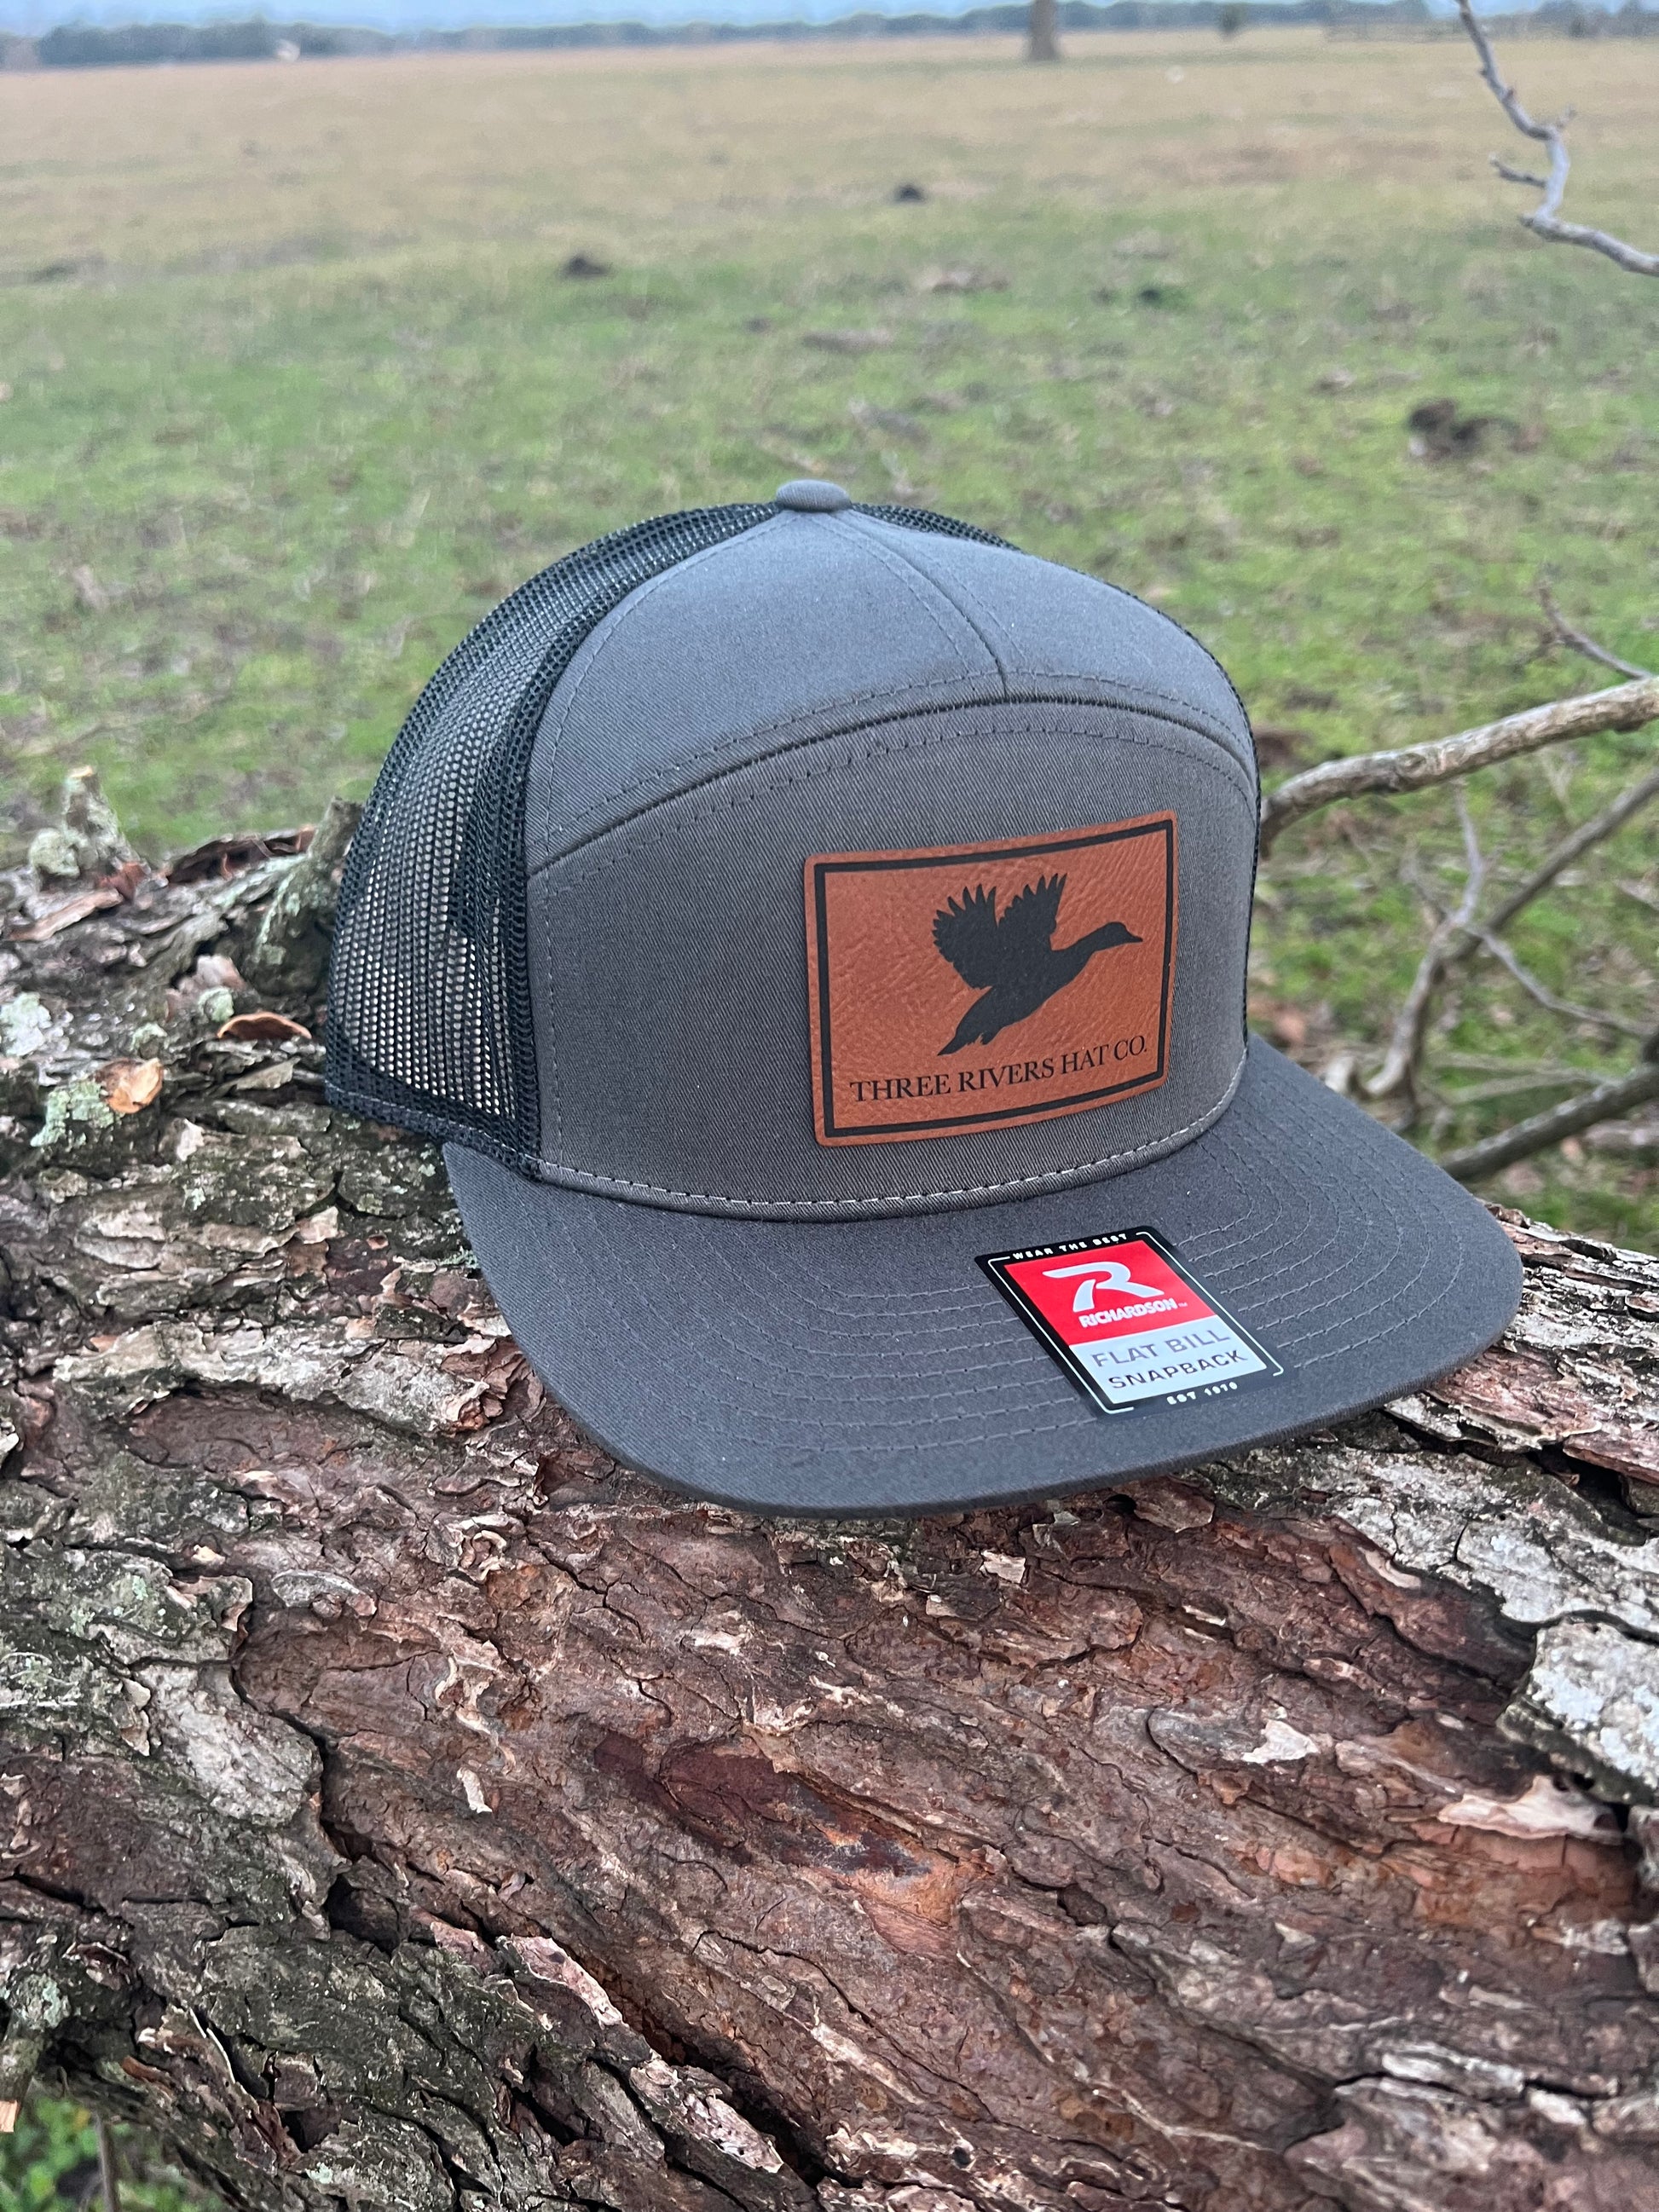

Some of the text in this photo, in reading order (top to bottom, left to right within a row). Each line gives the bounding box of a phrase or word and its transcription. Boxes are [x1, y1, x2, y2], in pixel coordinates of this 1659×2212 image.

[850, 1035, 1147, 1101] THREE RIVERS HAT CO.
[1013, 1247, 1054, 1260] WEAR
[1059, 1241, 1087, 1252] THE
[1078, 1297, 1177, 1328] RICHARDSON
[1091, 1330, 1230, 1367] FLAT BILL
[1108, 1349, 1248, 1389] SNAPBACK
